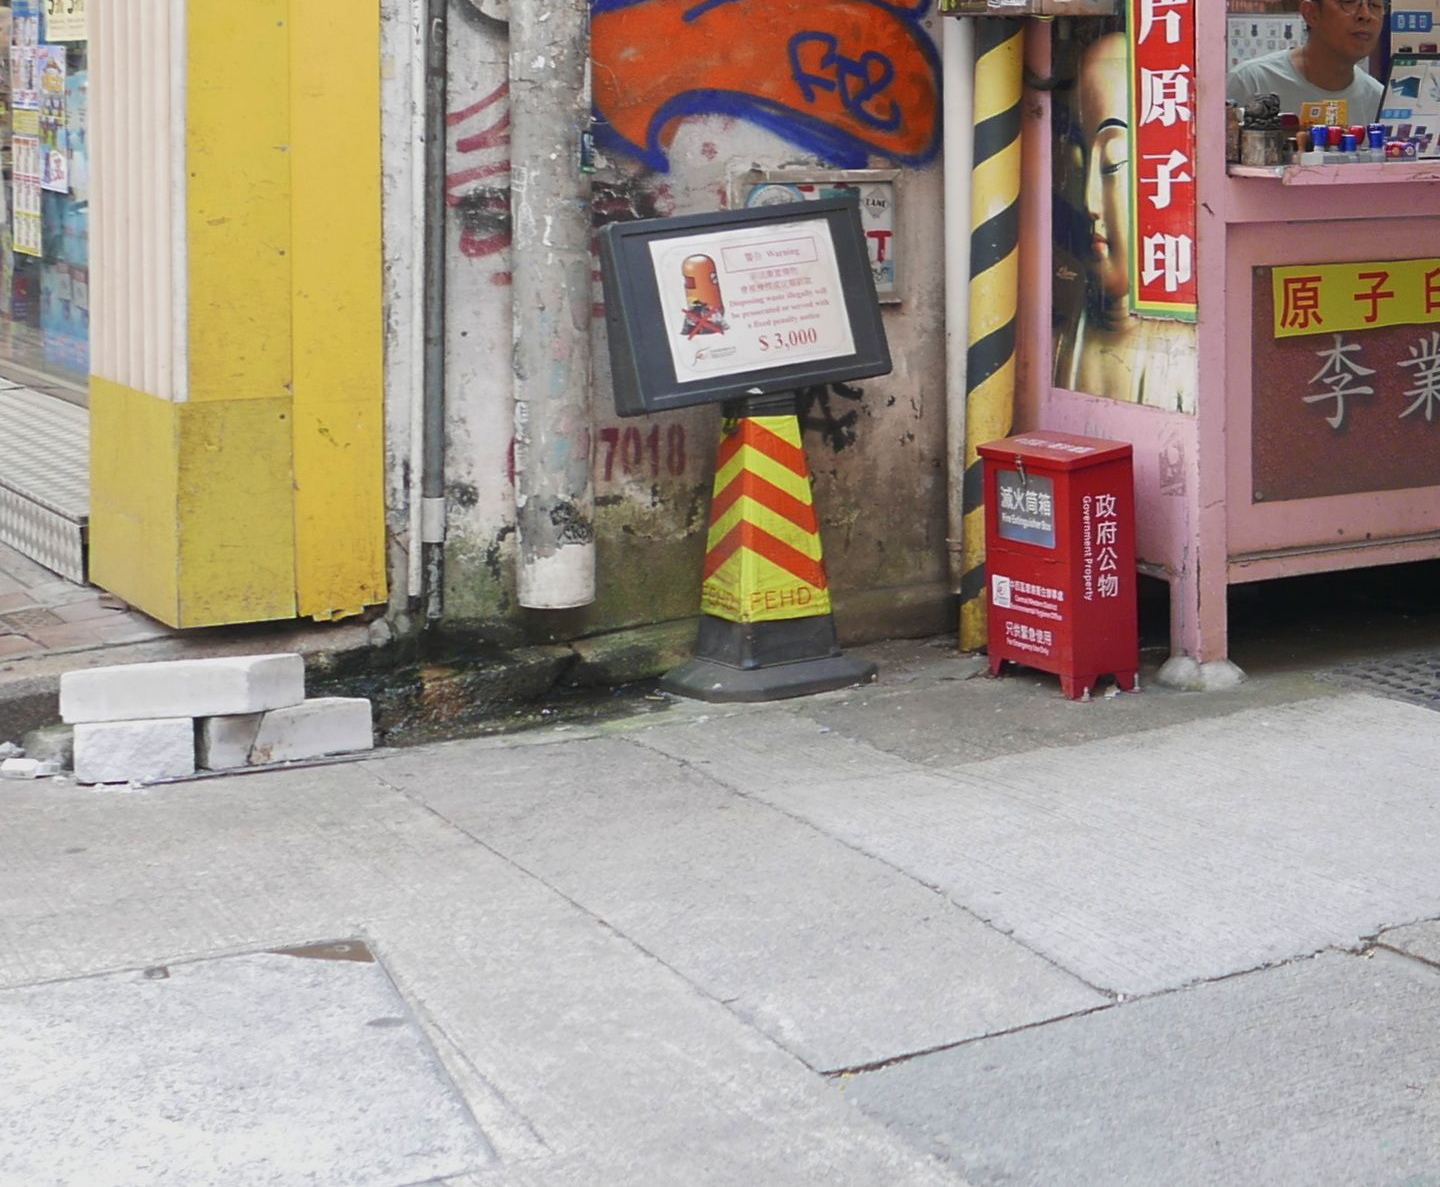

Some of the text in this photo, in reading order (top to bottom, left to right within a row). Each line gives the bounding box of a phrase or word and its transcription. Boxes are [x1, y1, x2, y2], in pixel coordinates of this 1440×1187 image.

[767, 248, 800, 259] Warning
[758, 327, 818, 352] $ 3,000
[1082, 495, 1093, 601] Government Property
[1095, 494, 1119, 598] 政府公物
[751, 586, 812, 611] FEHD
